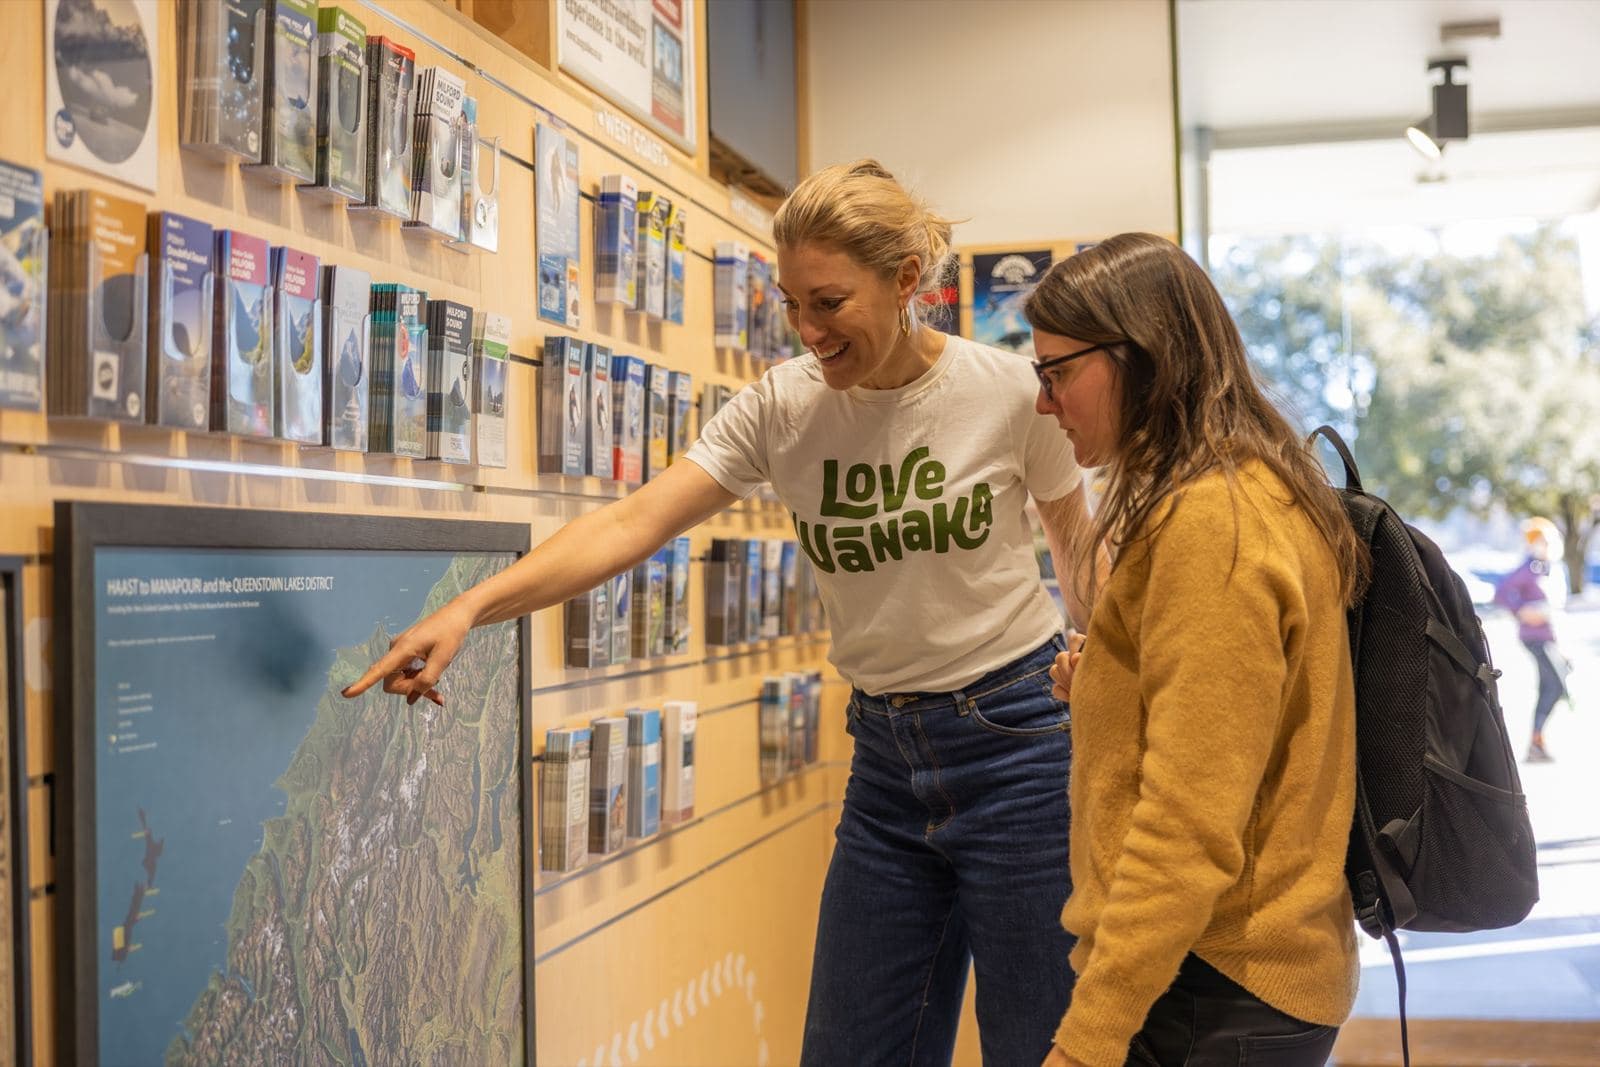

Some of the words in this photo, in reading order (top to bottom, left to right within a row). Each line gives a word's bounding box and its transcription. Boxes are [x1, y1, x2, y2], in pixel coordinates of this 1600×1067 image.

[437, 80, 460, 100] MILFORD
[436, 91, 454, 109] SOUND
[606, 116, 631, 145] WEST
[446, 306, 467, 320] MILFORD
[446, 318, 462, 330] SOUND
[107, 578, 139, 596] HAAST
[139, 579, 149, 595] to
[202, 577, 218, 594] and
[218, 577, 232, 593] the
[233, 577, 284, 593] QUEENSTOWN
[284, 576, 305, 591] LAKES
[305, 576, 334, 591] DISTRICT
